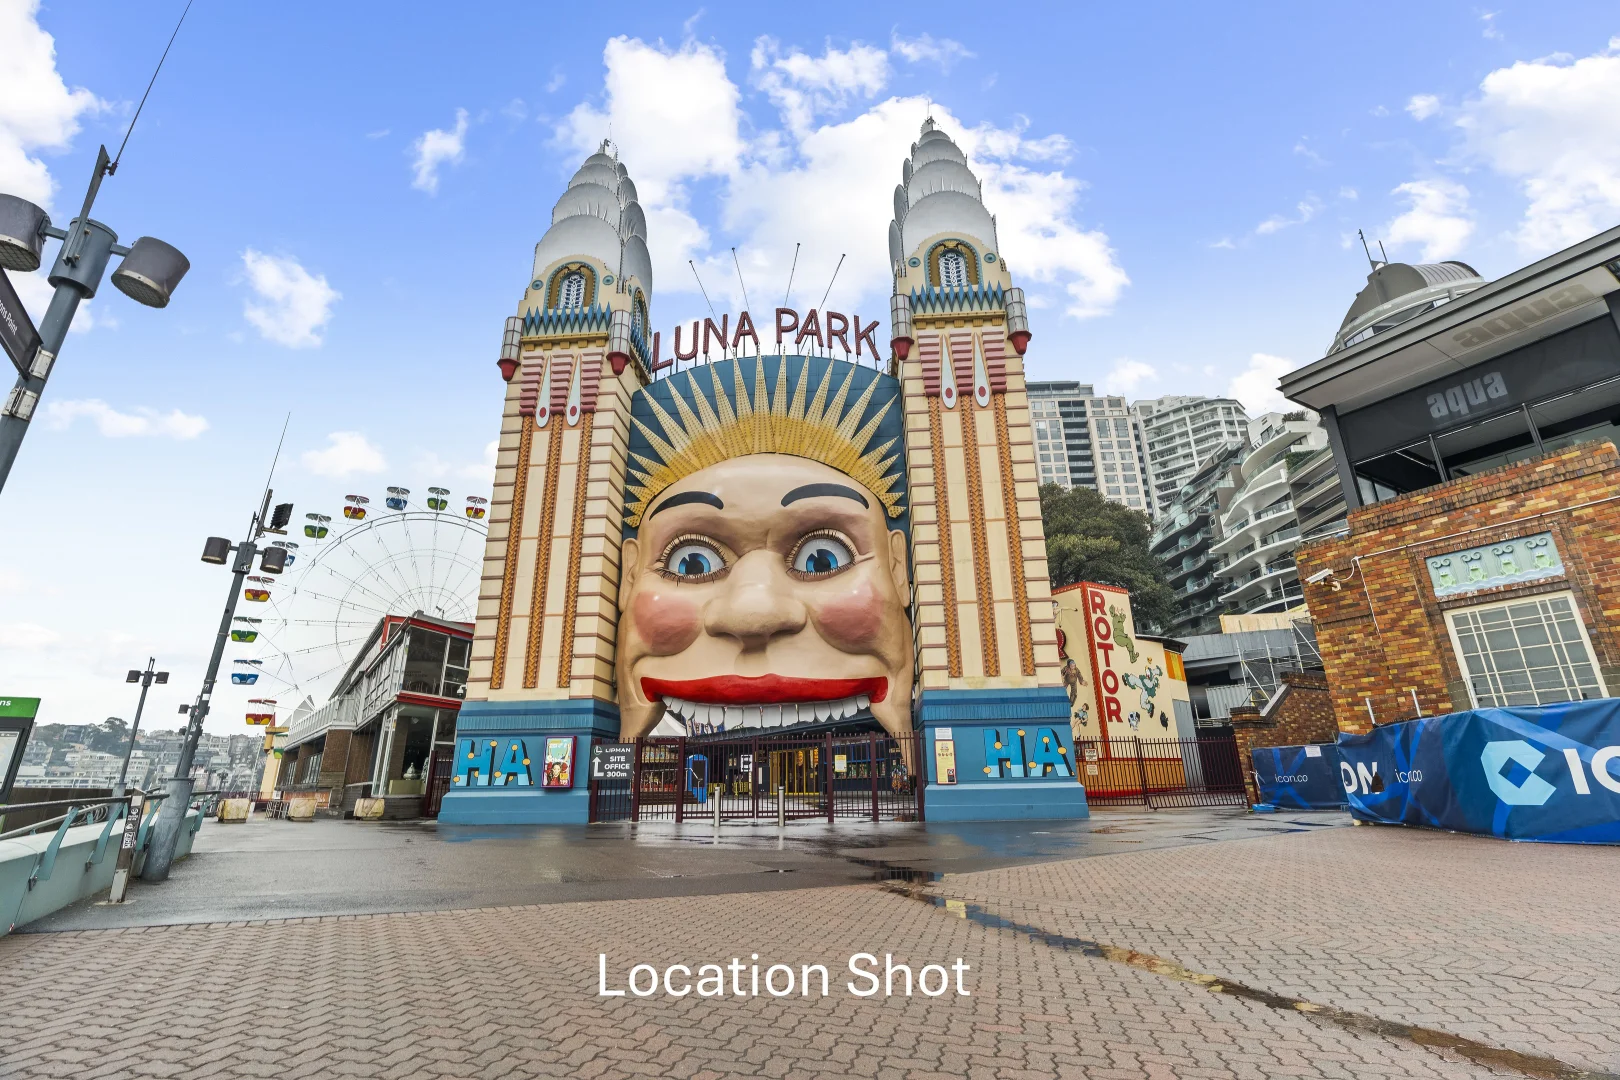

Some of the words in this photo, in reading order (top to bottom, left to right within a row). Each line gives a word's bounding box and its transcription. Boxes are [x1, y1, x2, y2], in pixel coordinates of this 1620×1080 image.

[652, 310, 759, 372] LUNA
[775, 308, 881, 361] PARK
[1426, 371, 1508, 419] aqua
[1089, 589, 1124, 723] ROTOR
[454, 739, 534, 787] HA
[983, 727, 1075, 778] HA
